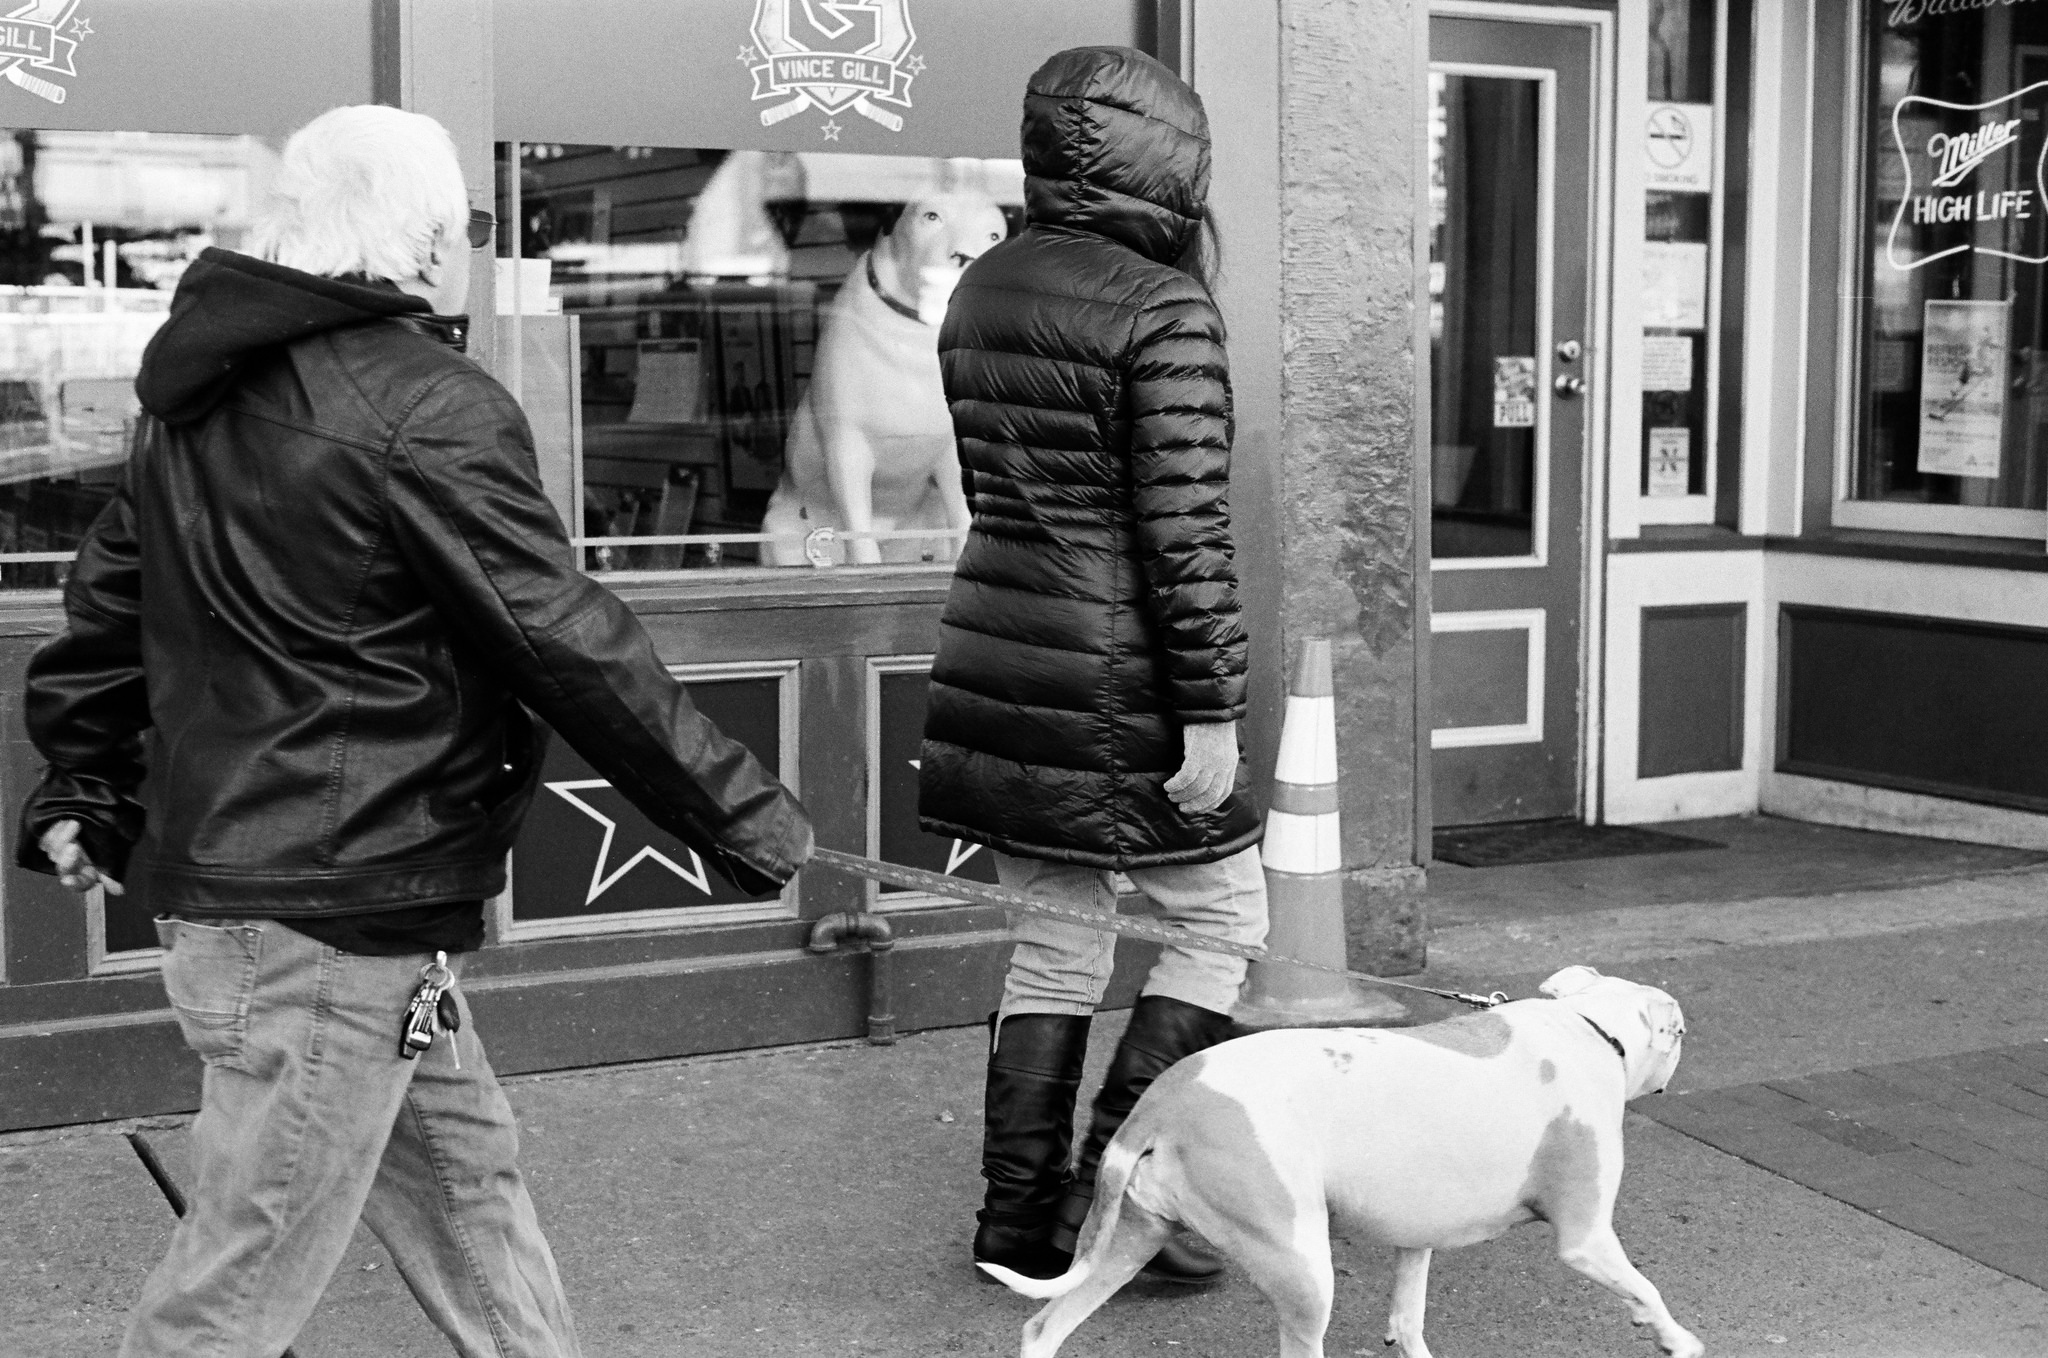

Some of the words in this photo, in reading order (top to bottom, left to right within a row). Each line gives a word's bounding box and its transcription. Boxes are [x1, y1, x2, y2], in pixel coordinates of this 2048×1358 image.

[777, 59, 835, 80] VINCE
[841, 60, 885, 85] GILL
[1927, 118, 2021, 188] Miller
[1913, 194, 1973, 225] HIGH
[1976, 189, 2033, 222] LIFE
